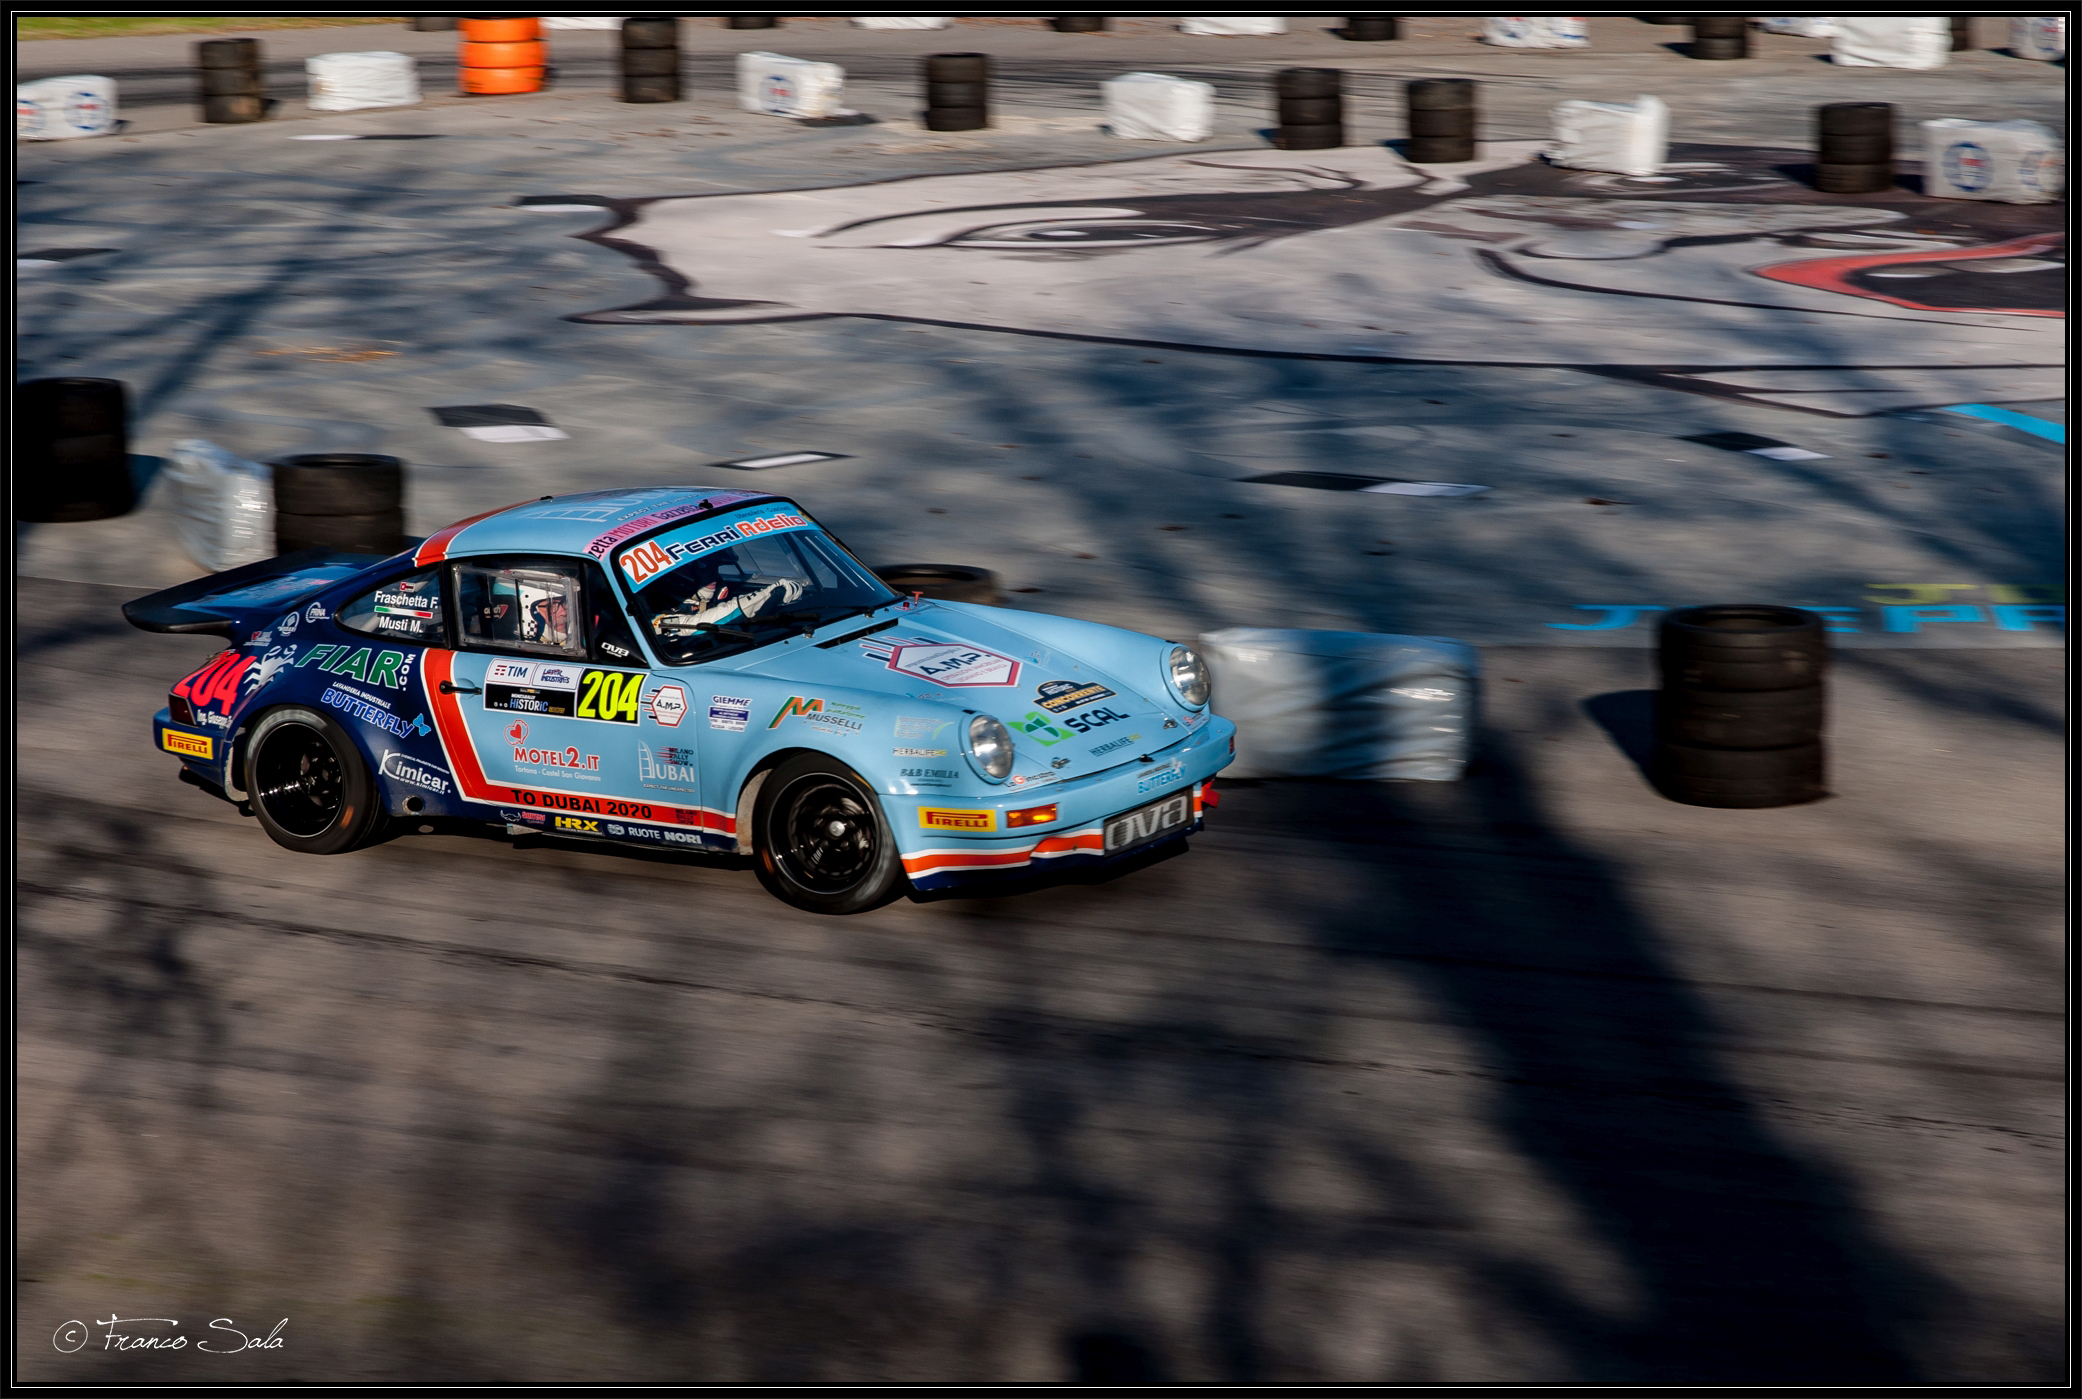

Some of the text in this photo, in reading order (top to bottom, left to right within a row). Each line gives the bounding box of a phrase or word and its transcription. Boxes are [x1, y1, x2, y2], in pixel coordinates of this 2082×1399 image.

[620, 541, 673, 583] 204
[374, 590, 438, 609] Fraschetta F.
[379, 615, 424, 633] Musti M.
[294, 644, 402, 689] FIAR
[507, 666, 528, 678] TIM
[332, 681, 392, 710] LAVANDERIA INDUSTRIALE
[577, 670, 645, 721] 204
[712, 695, 751, 706] GIEMME
[320, 688, 415, 738] BUTTERFLY
[805, 713, 863, 731] MUSSELLI
[1063, 706, 1131, 733] SCAL
[167, 733, 208, 755] PIRELLI
[514, 745, 600, 771] MOTEL2.IT
[515, 765, 537, 775] Tortona
[541, 768, 560, 778] Castel
[561, 770, 573, 779] San
[399, 778, 445, 795] www.kimicar.it
[511, 789, 653, 820] TO DUBAI 2020
[554, 816, 599, 832] HRX
[925, 811, 989, 828] PIRELLI
[627, 827, 661, 840] RUOTE
[663, 831, 702, 845] NORI
